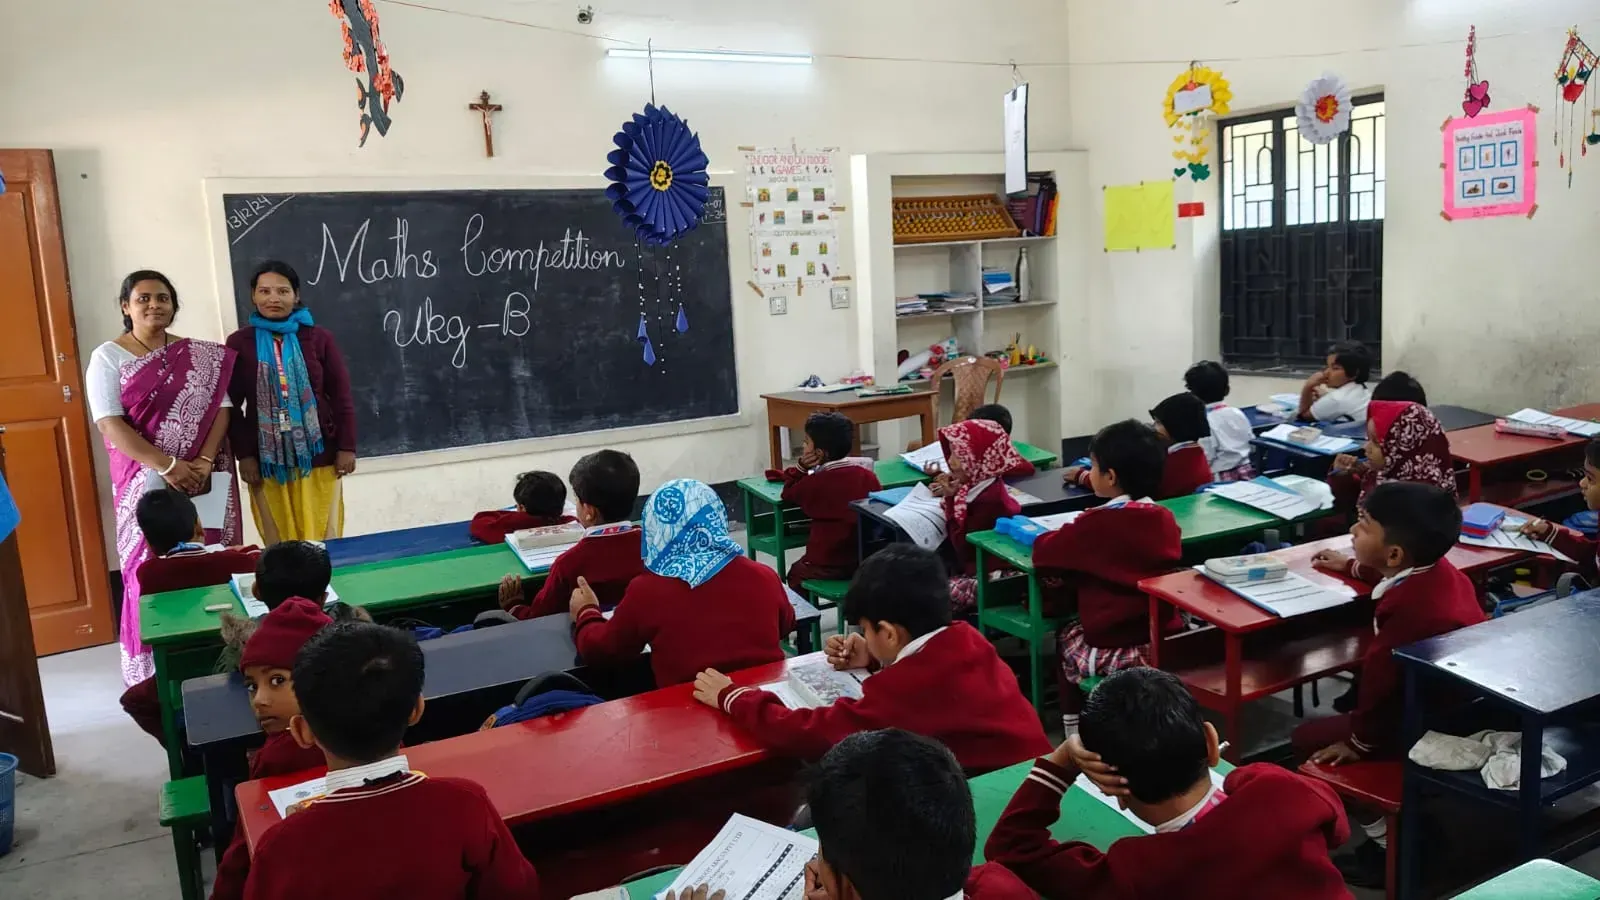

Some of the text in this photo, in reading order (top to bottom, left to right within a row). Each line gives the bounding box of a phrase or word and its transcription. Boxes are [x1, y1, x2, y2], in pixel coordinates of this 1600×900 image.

[227, 195, 272, 230] 13/12/24
[307, 213, 625, 292] Maths Competition
